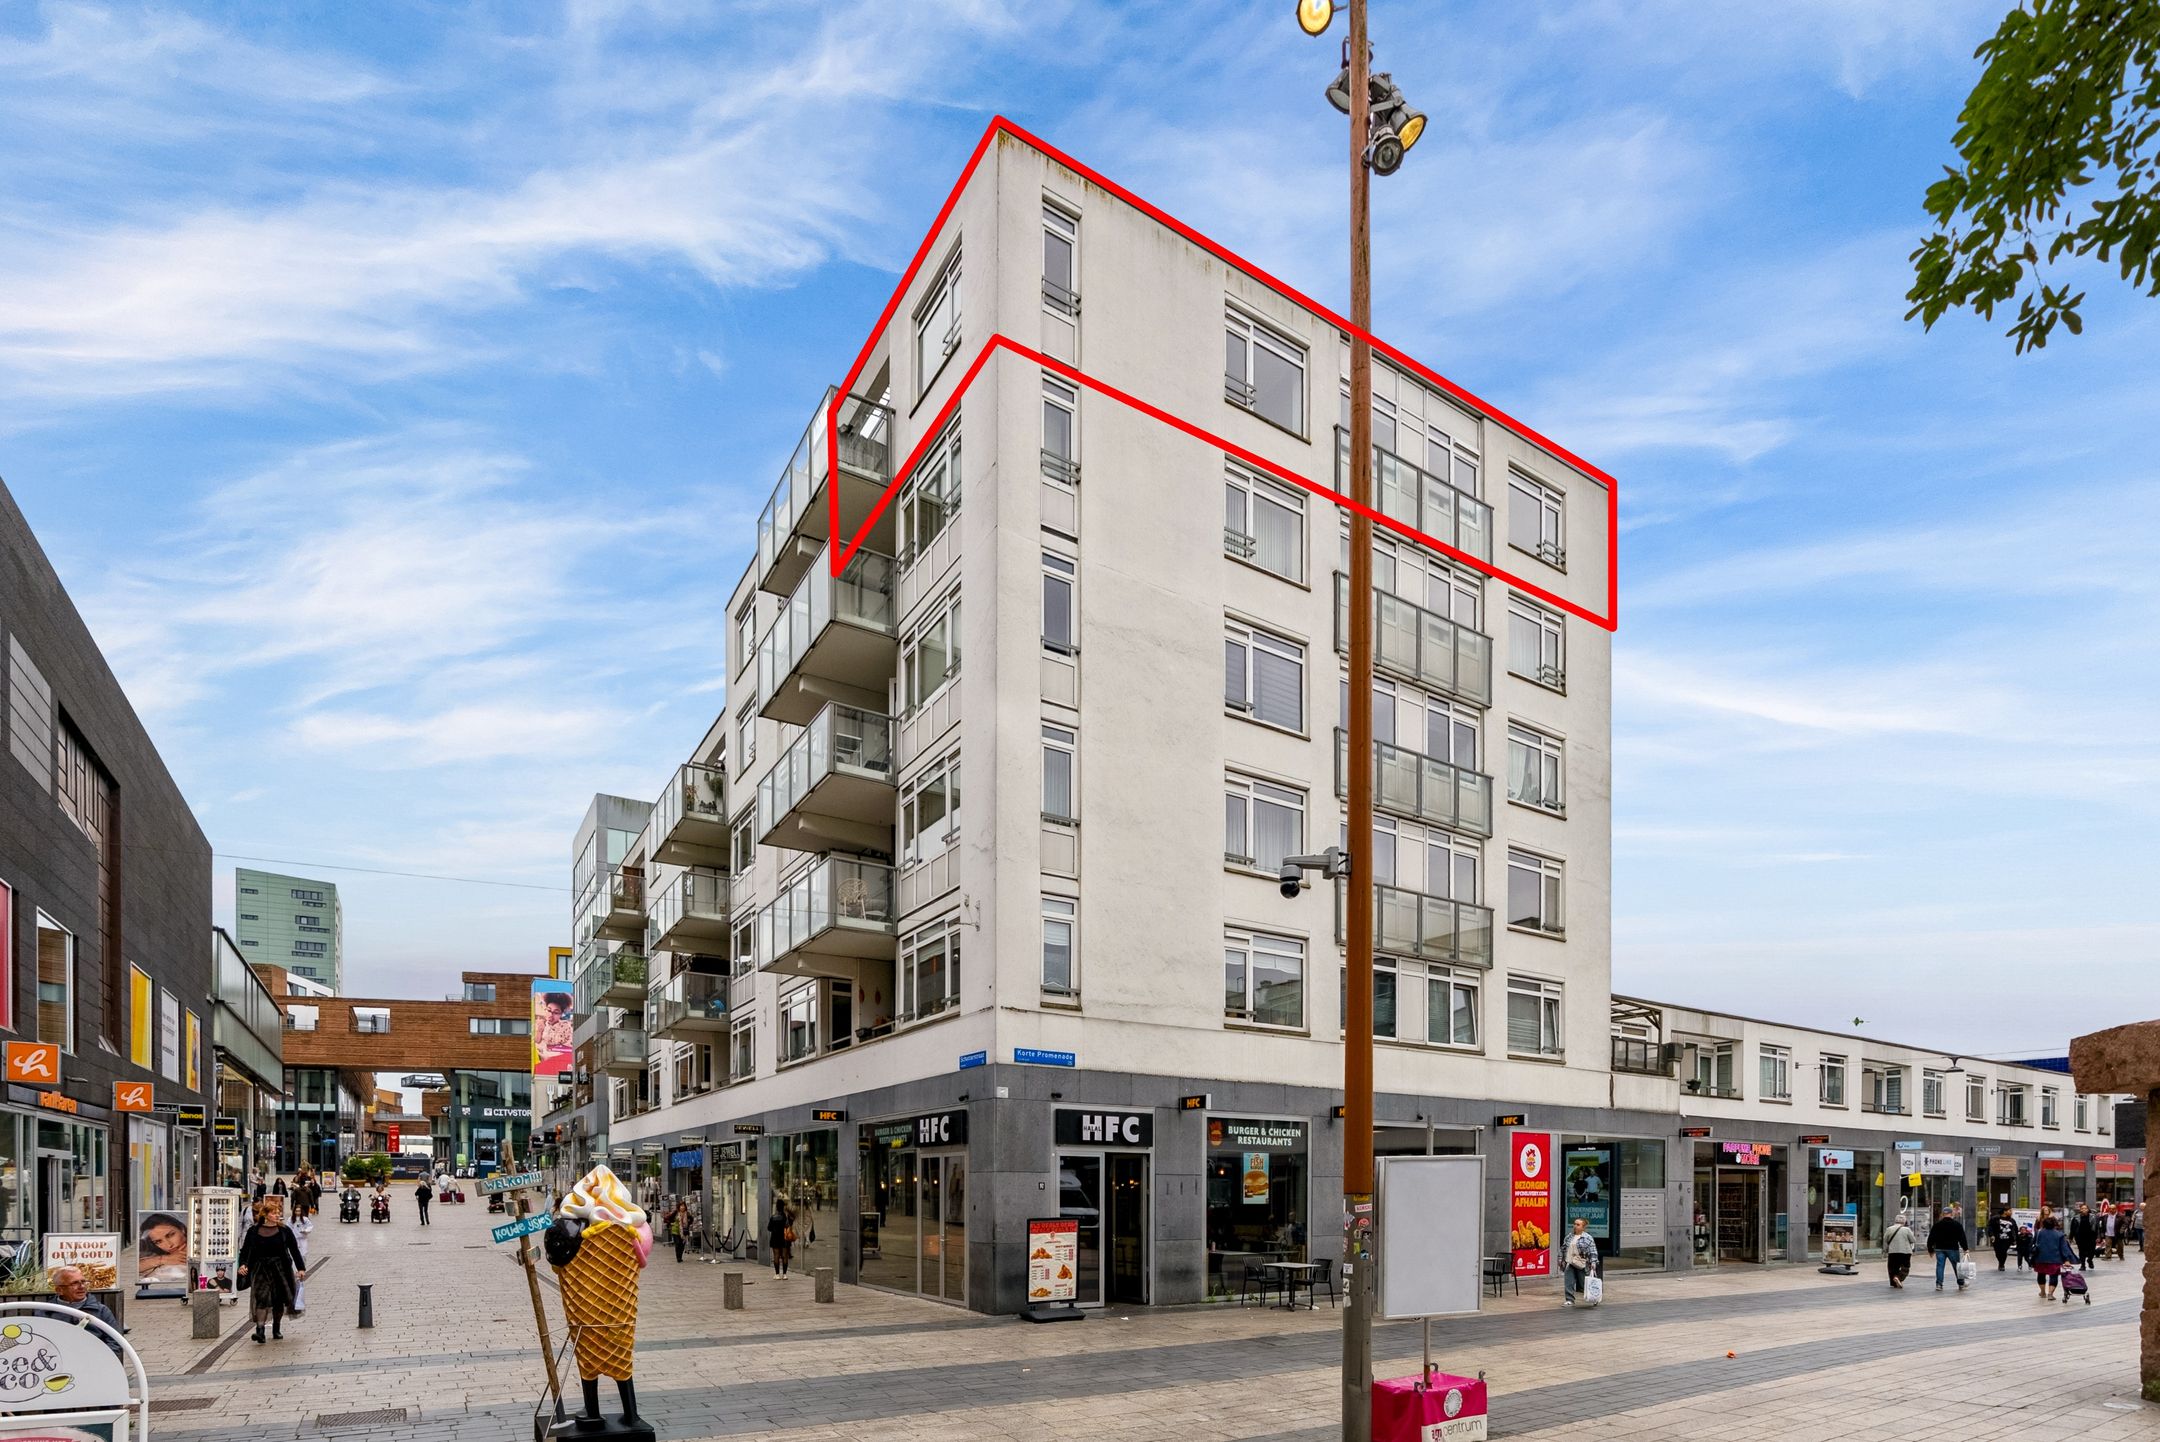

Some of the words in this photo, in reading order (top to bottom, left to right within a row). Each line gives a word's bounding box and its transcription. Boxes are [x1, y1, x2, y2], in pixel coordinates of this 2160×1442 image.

[1017, 1049, 1036, 1057] Korte
[1037, 1051, 1073, 1061] Promenade
[1187, 1098, 1200, 1108] HFC
[819, 1111, 837, 1120] HFC
[1502, 1116, 1518, 1125] HFC
[920, 1115, 950, 1144] HFC
[1082, 1114, 1140, 1143] HFC
[1228, 1126, 1259, 1136] BURGER
[1261, 1127, 1266, 1136] &
[1268, 1128, 1301, 1138] CHICKEN
[1237, 1136, 1292, 1146] RESTAURANTS
[1515, 1181, 1548, 1190] BEZORGEN
[1515, 1198, 1548, 1208] AFHALEN
[59, 1241, 107, 1250] INKOOP
[52, 1251, 78, 1260] OUD
[81, 1251, 114, 1259] GOUD
[1443, 1420, 1483, 1437] centrum
